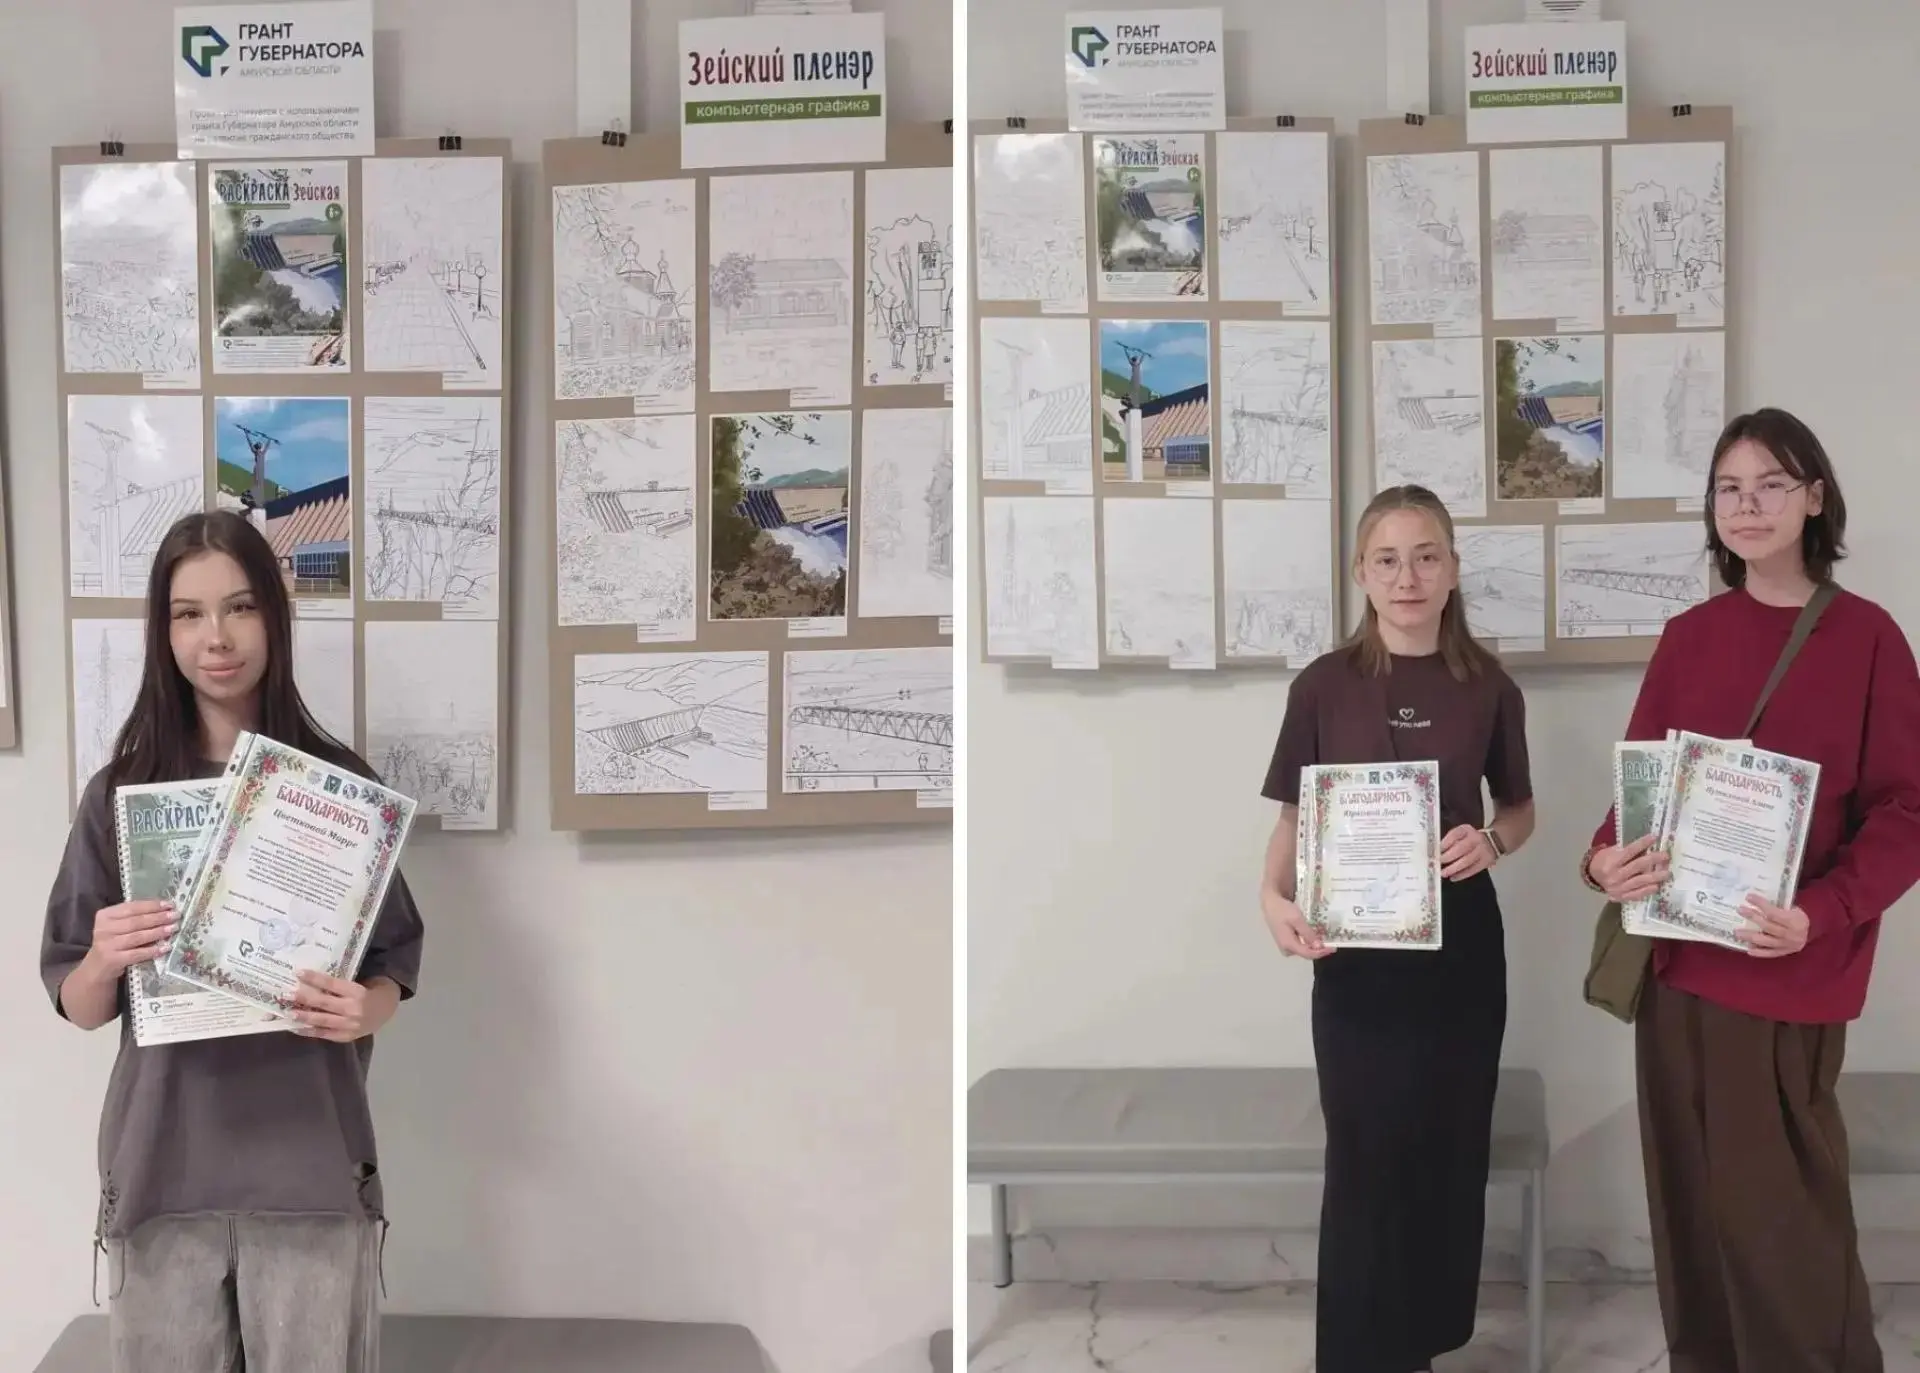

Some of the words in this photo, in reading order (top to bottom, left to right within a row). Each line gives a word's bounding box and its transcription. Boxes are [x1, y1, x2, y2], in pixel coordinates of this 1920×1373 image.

[239, 22, 294, 40] ГРАНТ
[1116, 25, 1161, 38] ГРАНТ
[239, 42, 365, 62] ГУБЕРНАТОРА
[1117, 40, 1217, 55] ГУБЕРНАТОРА
[687, 46, 785, 86] Зейский
[793, 50, 874, 90] пленэр
[1471, 47, 1548, 78] Зейский
[1554, 50, 1617, 82] пленэр
[1566, 88, 1615, 103] графика
[696, 102, 805, 118] компьютерная
[808, 98, 870, 115] графика
[292, 182, 340, 201] Зейская
[1705, 766, 1784, 798] БЛАГОДАРНОСТЬ
[133, 803, 211, 834] РАСКРАС
[276, 784, 369, 836] БЛАГОДАРНОСТЬ
